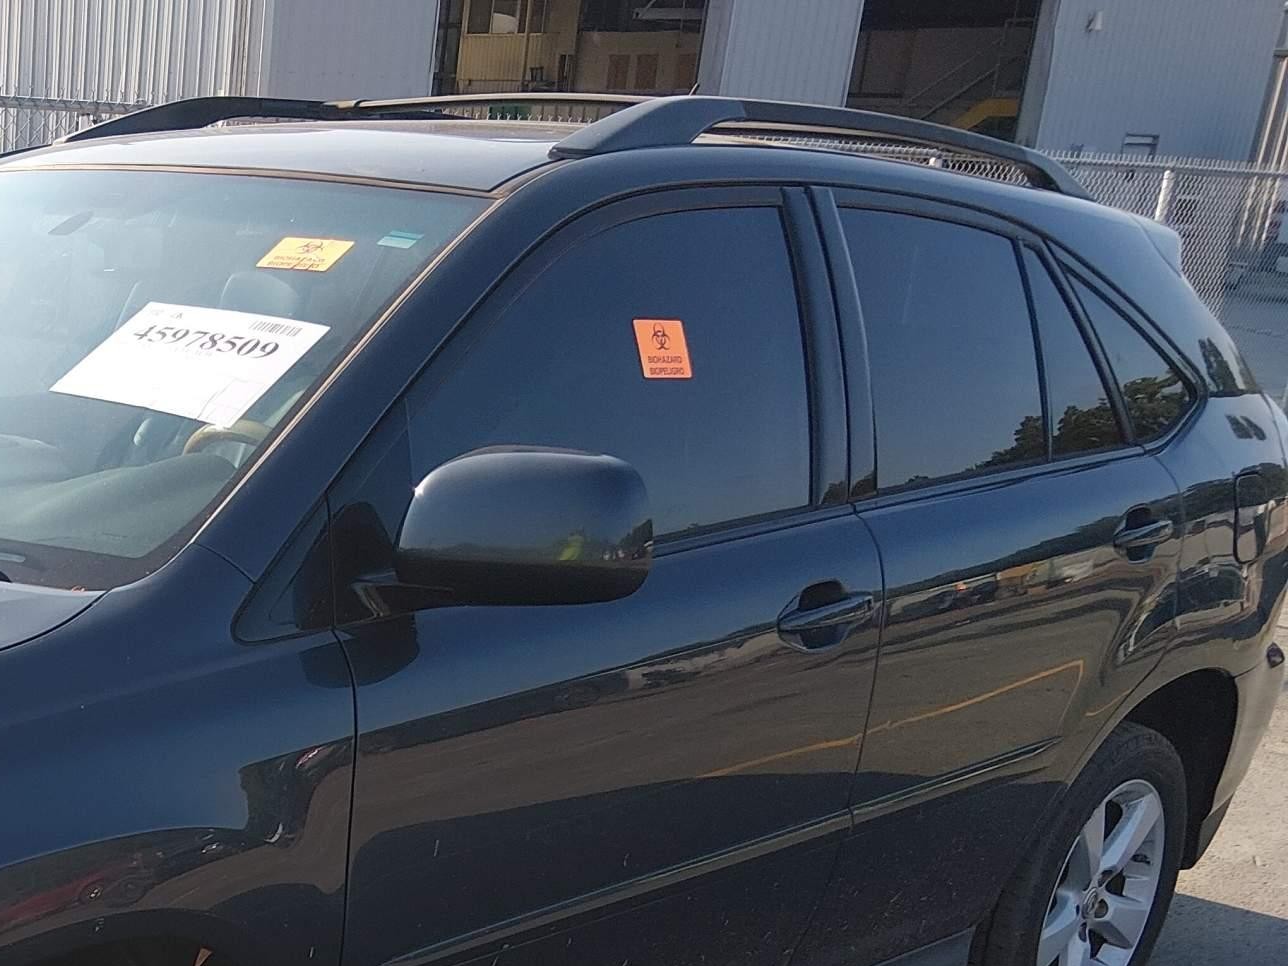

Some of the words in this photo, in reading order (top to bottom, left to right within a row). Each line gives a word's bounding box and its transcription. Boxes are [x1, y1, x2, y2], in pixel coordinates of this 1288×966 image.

[133, 324, 280, 359] 45978509
[647, 355, 682, 363] BIOHAZARD
[649, 367, 685, 375] BIOPELIGRO
